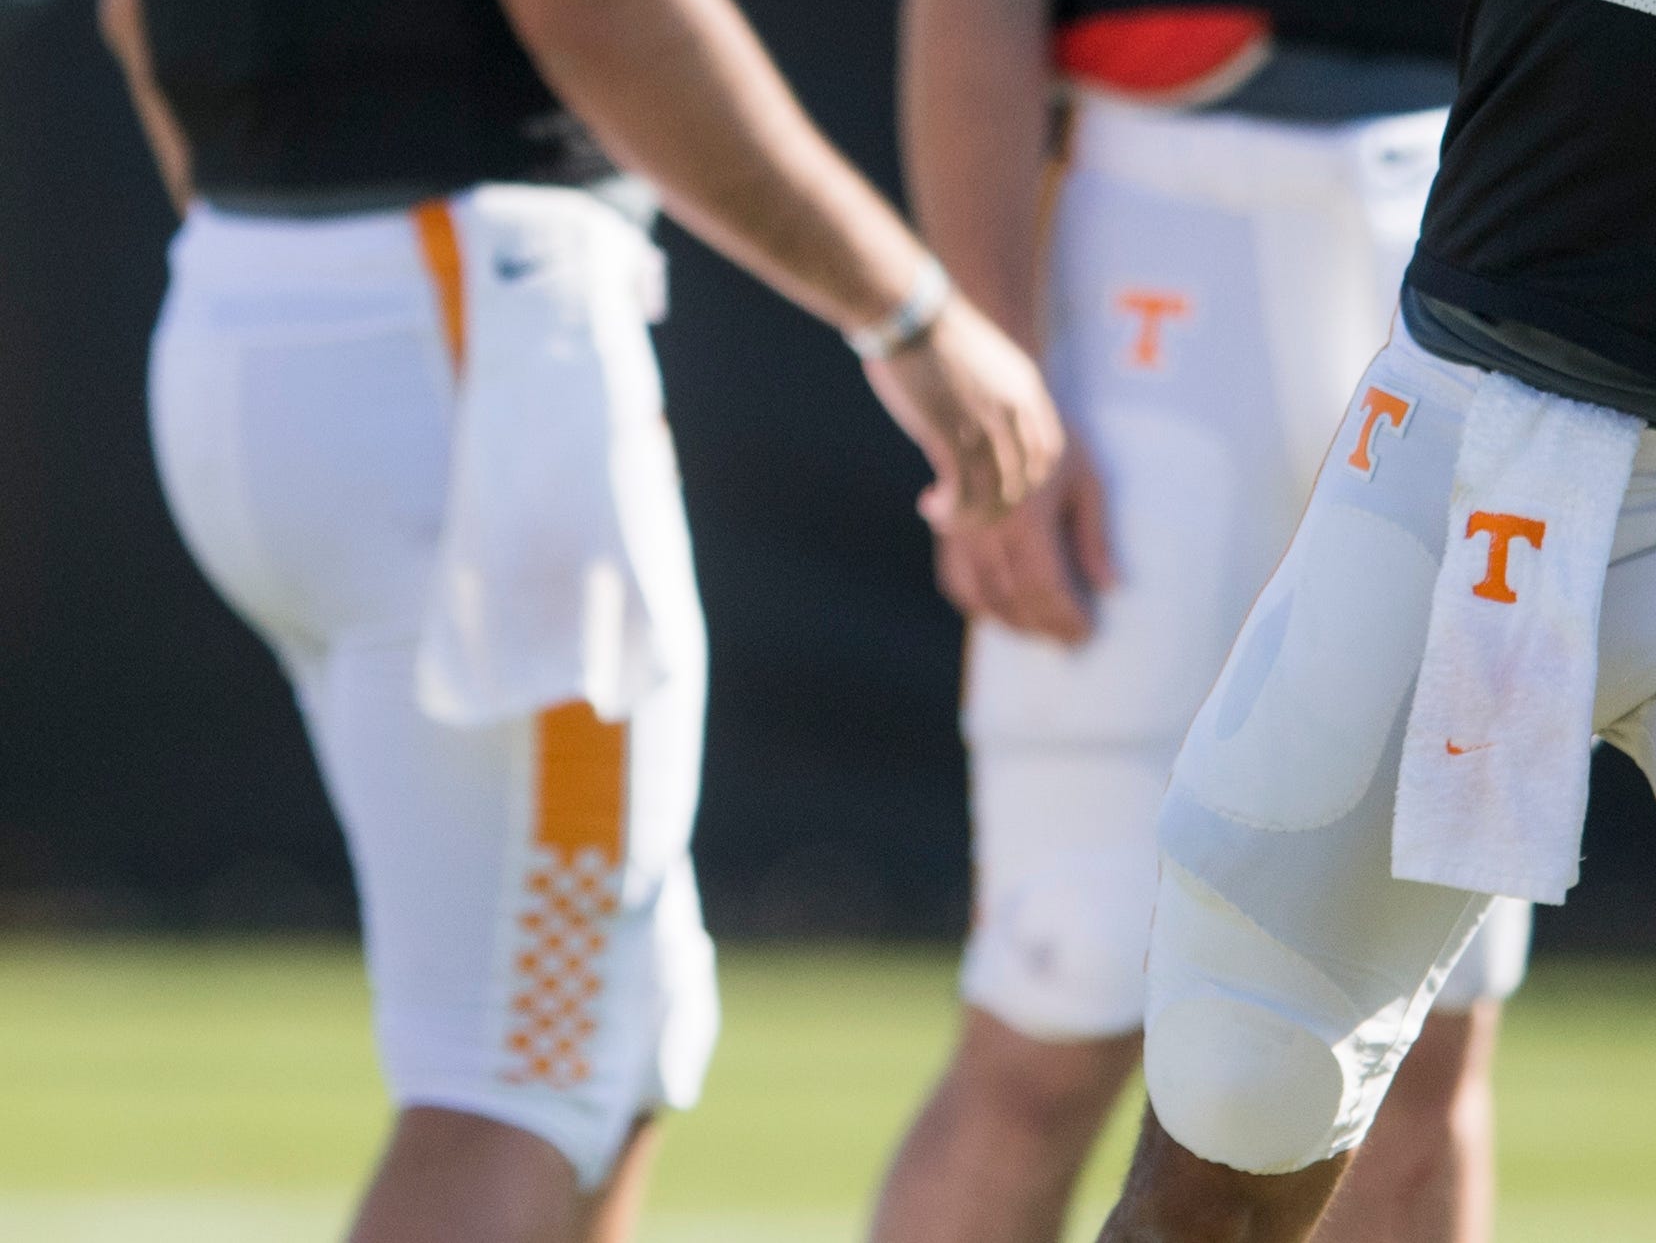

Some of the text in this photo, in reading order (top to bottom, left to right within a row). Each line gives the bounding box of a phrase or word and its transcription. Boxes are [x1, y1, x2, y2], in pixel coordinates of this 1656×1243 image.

[1112, 285, 1193, 371] T
[1348, 386, 1410, 472] T
[1465, 510, 1546, 605] T
